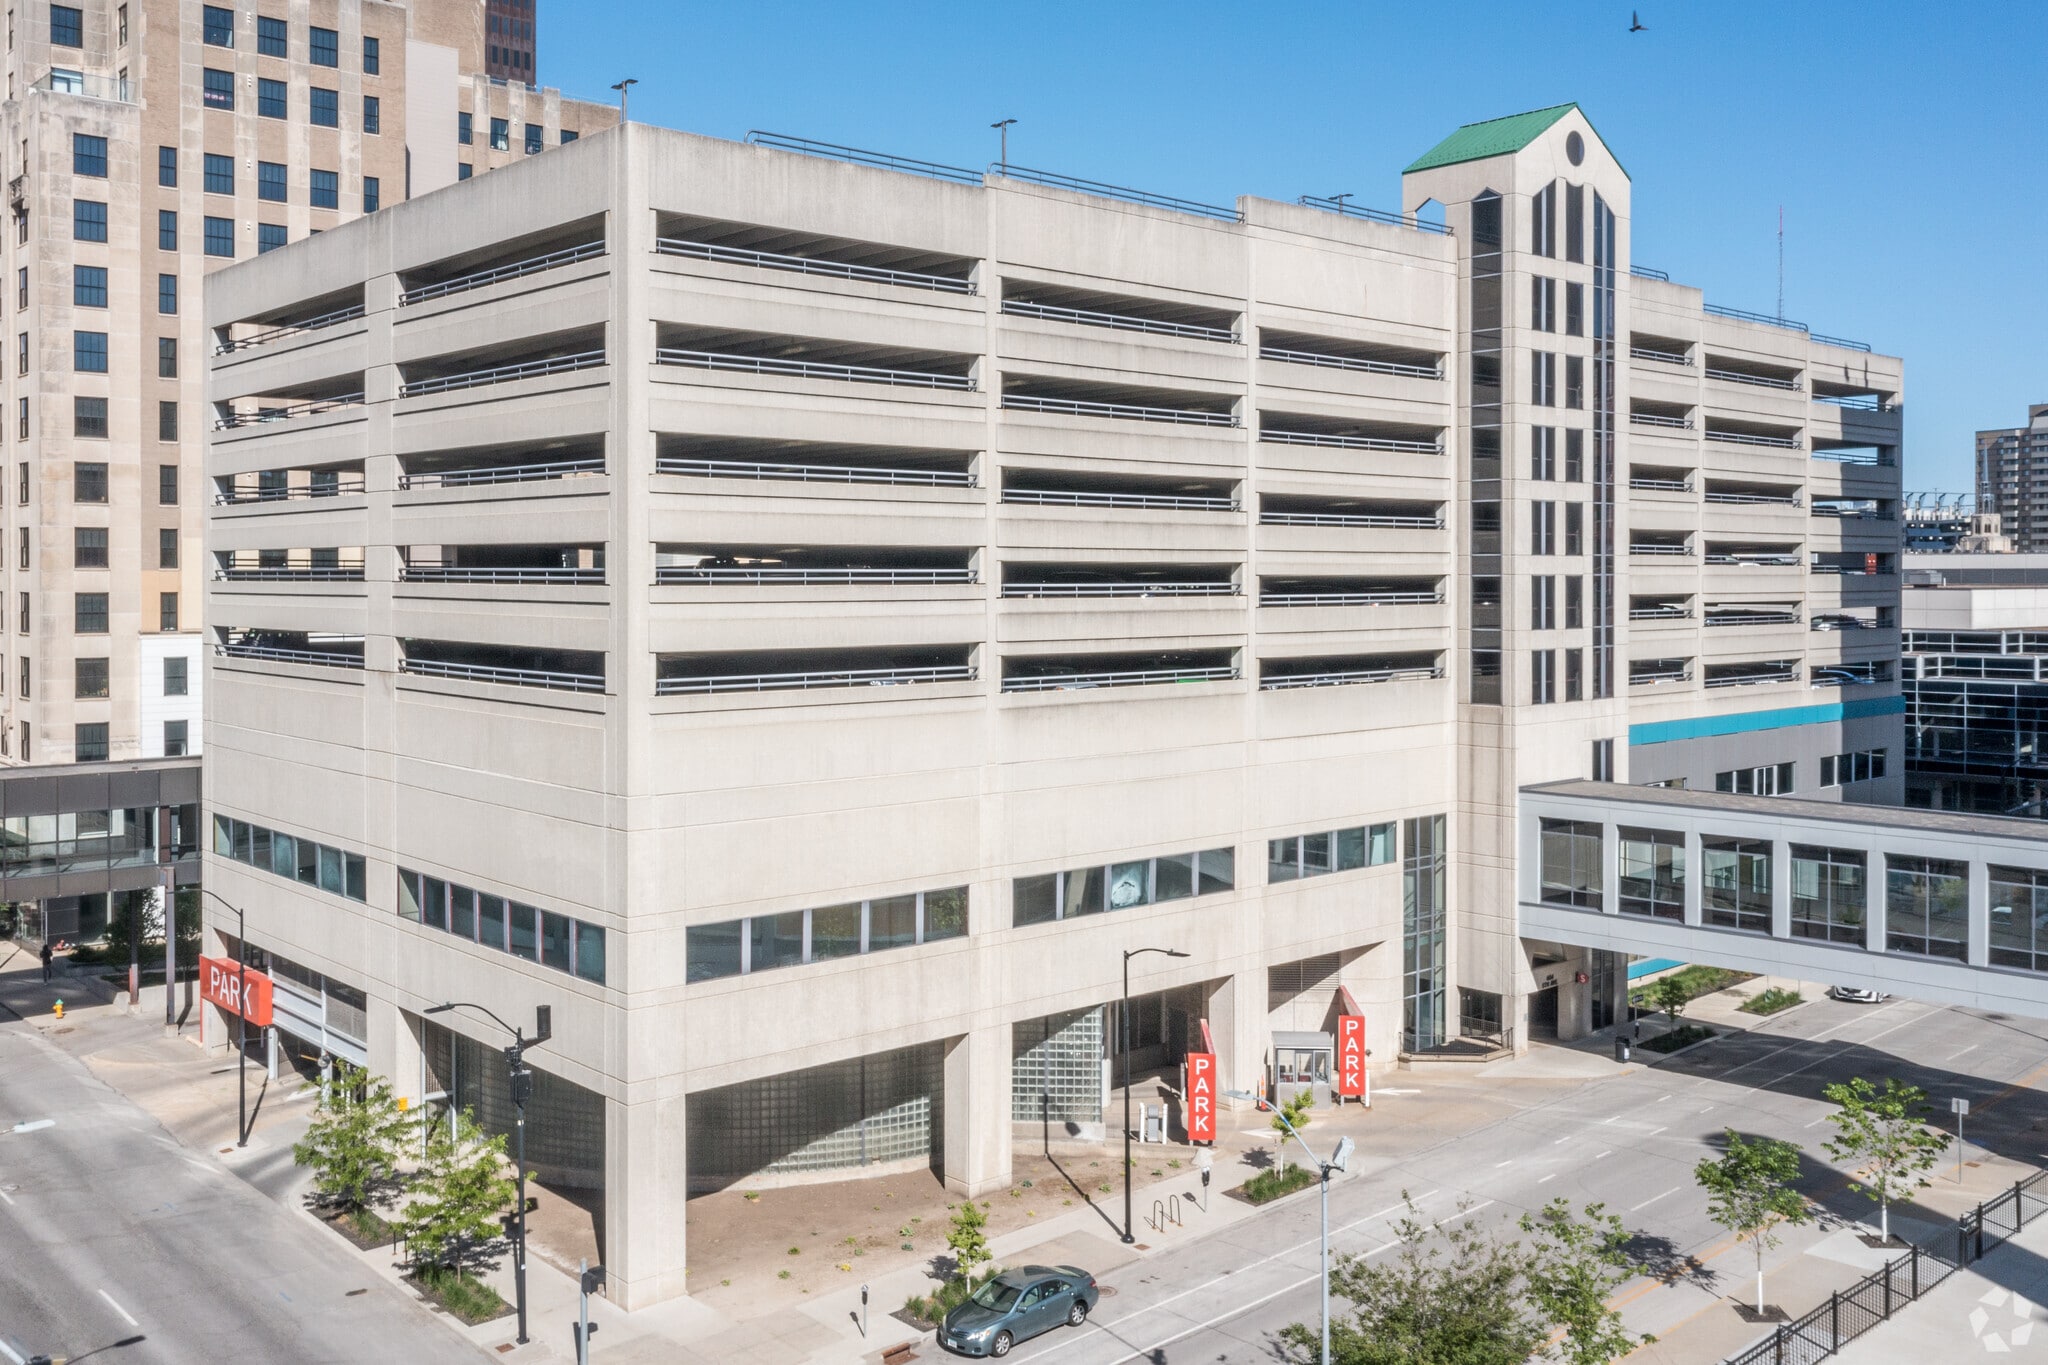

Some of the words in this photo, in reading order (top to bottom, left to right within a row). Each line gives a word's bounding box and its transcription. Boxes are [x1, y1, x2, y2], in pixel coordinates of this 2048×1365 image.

[210, 965, 252, 1016] PARK
[1580, 974, 1586, 983] S
[1345, 1020, 1359, 1088] PARK
[1194, 1058, 1210, 1132] PARK
